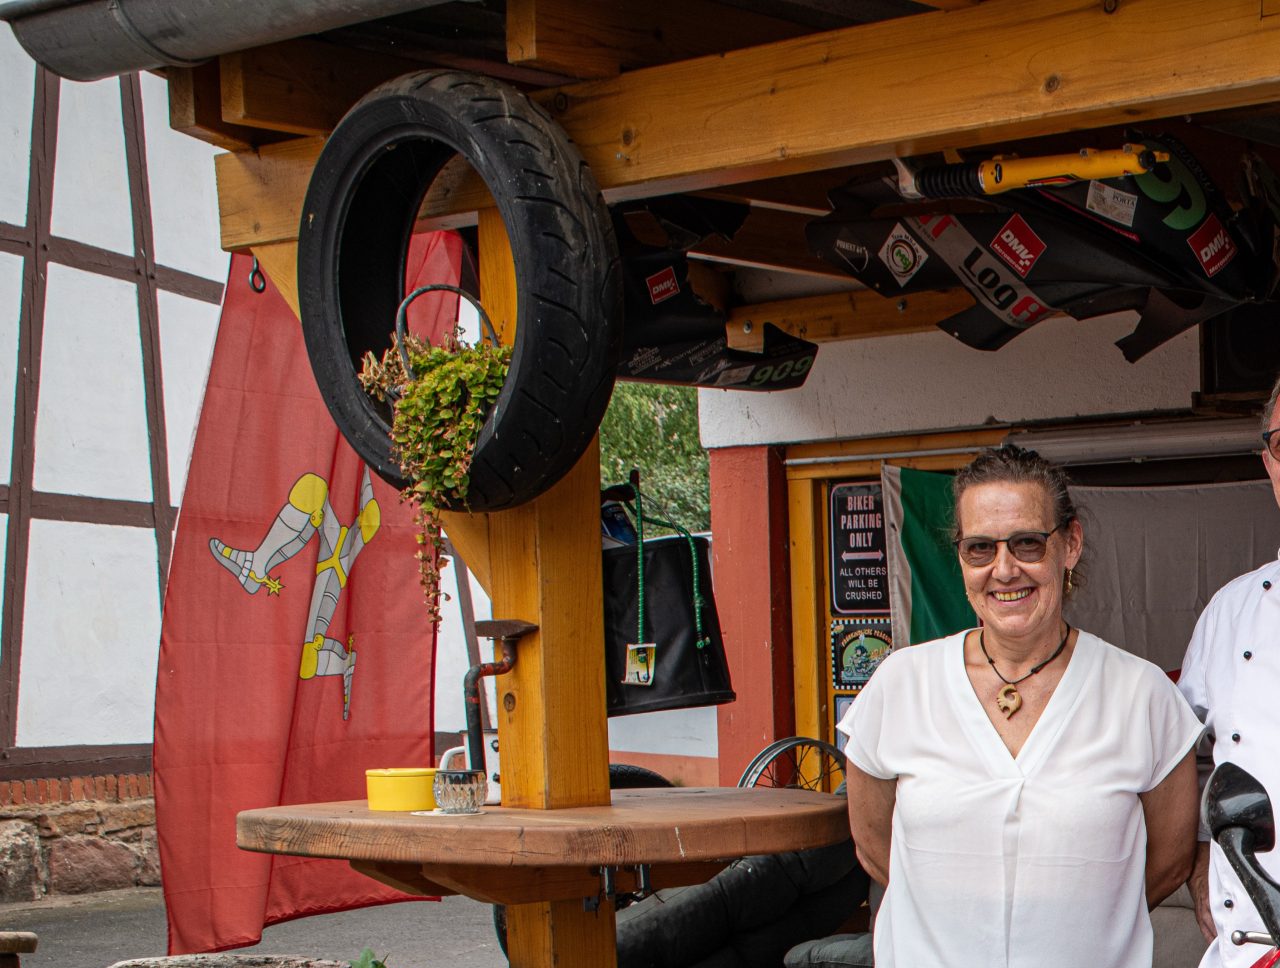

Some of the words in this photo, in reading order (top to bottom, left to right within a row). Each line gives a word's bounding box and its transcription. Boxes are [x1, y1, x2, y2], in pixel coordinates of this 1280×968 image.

[1000, 228, 1036, 266] DMV
[1200, 231, 1230, 263] DMV
[847, 495, 875, 511] BIKER
[840, 513, 882, 530] PARKING
[849, 532, 873, 549] ONLY
[839, 567, 854, 577] ALL
[855, 566, 887, 577] OTHERS
[848, 579, 866, 589] WILL
[867, 579, 879, 588] BE
[845, 591, 882, 600] CRUSHED
